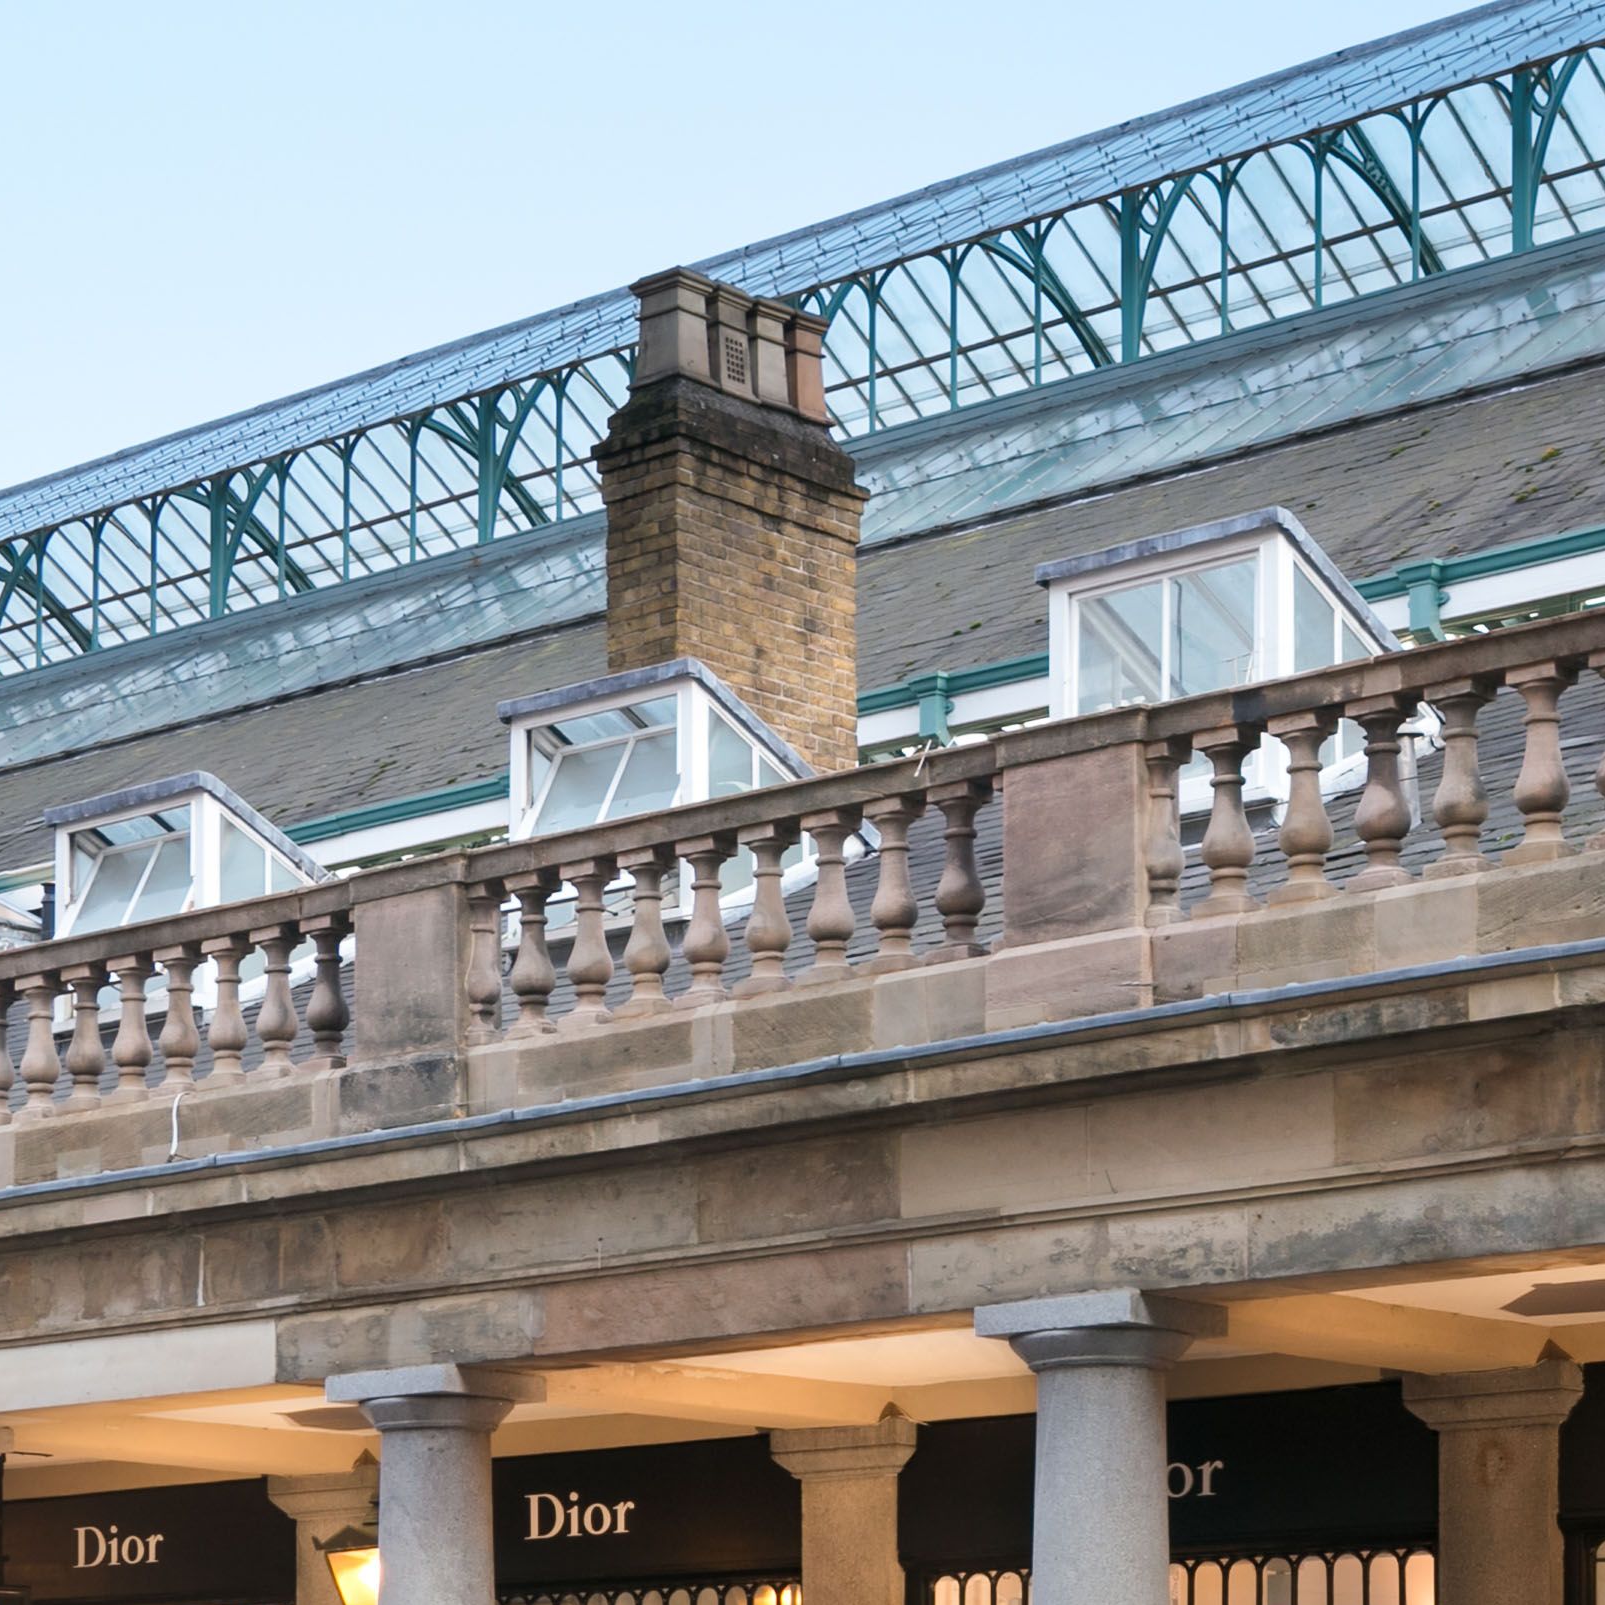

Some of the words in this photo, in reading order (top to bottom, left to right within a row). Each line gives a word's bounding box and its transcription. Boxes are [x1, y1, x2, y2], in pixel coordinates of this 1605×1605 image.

[1167, 1460, 1224, 1498] or
[524, 1491, 635, 1540] Dior
[73, 1525, 164, 1568] Dior
